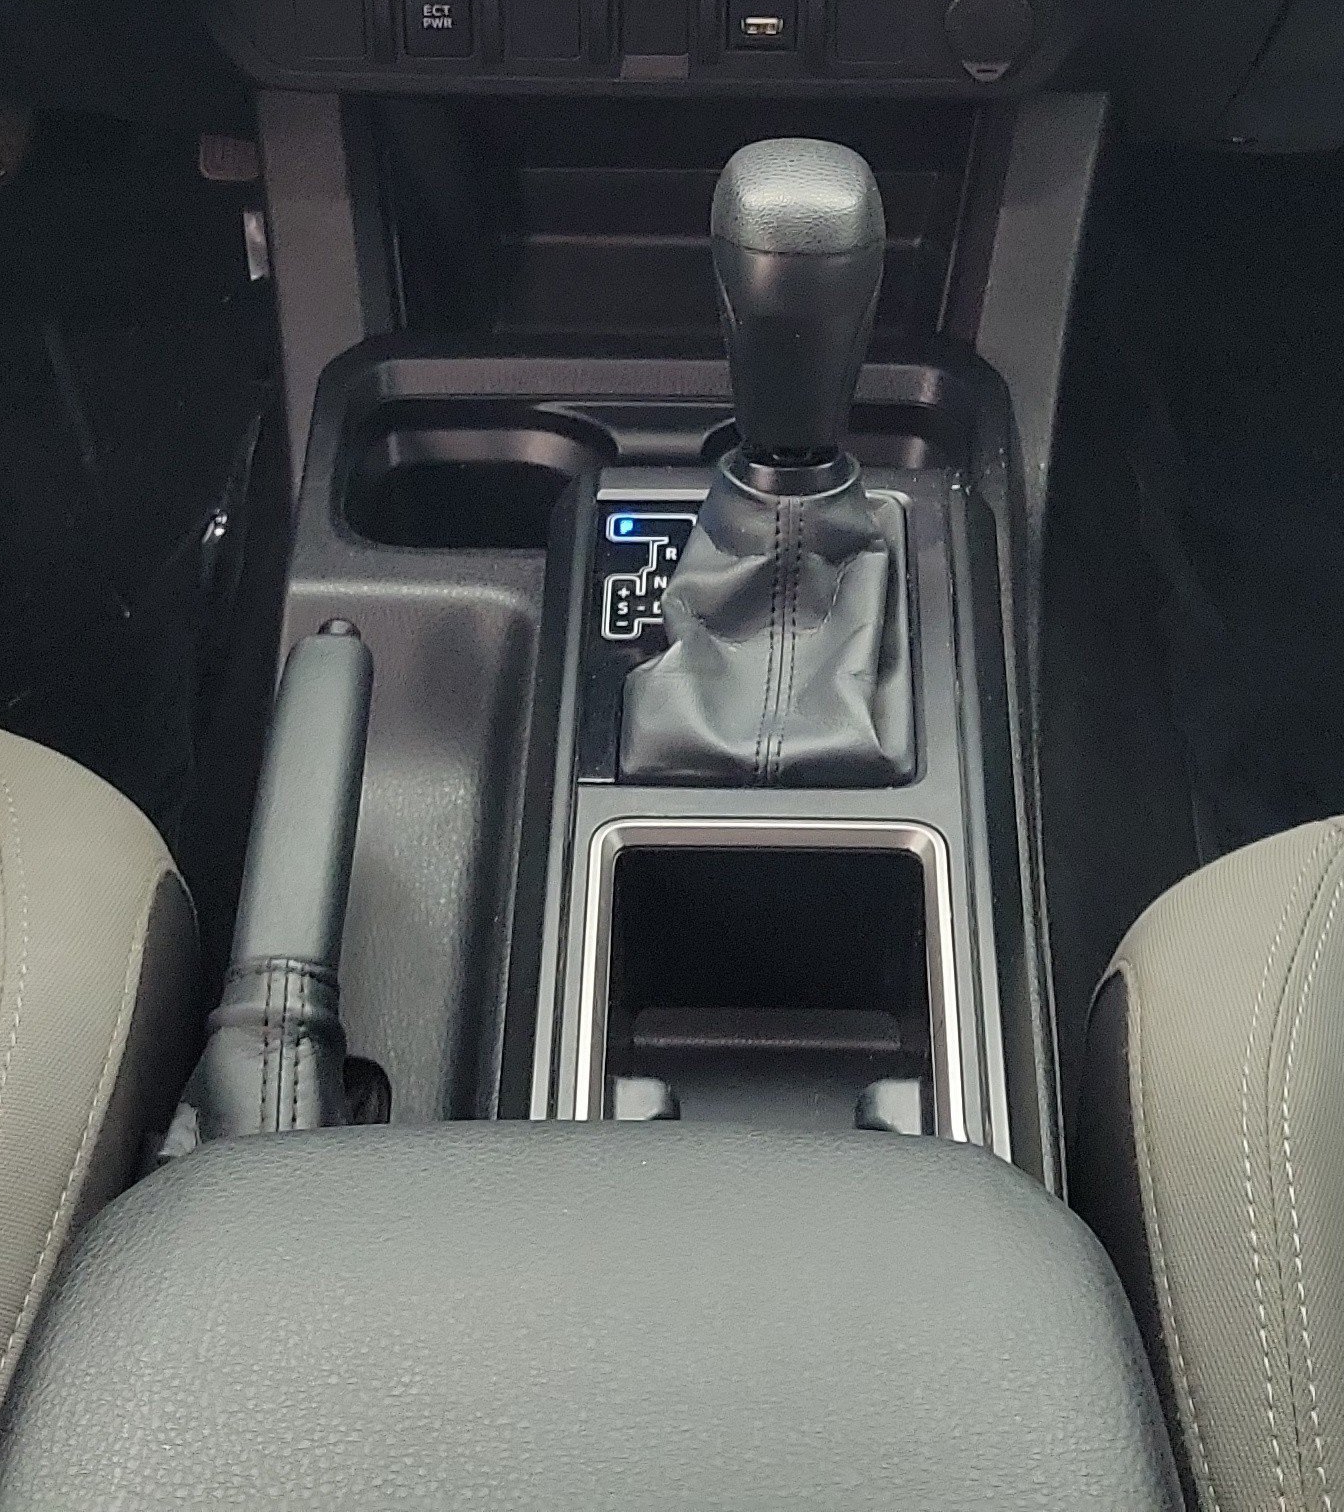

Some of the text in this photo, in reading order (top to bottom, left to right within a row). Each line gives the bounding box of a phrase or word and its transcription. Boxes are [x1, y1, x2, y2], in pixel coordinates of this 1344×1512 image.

[422, 3, 452, 16] ECT
[422, 16, 454, 29] PWR
[665, 547, 677, 561] R
[654, 576, 667, 589] N
[616, 601, 629, 615] S
